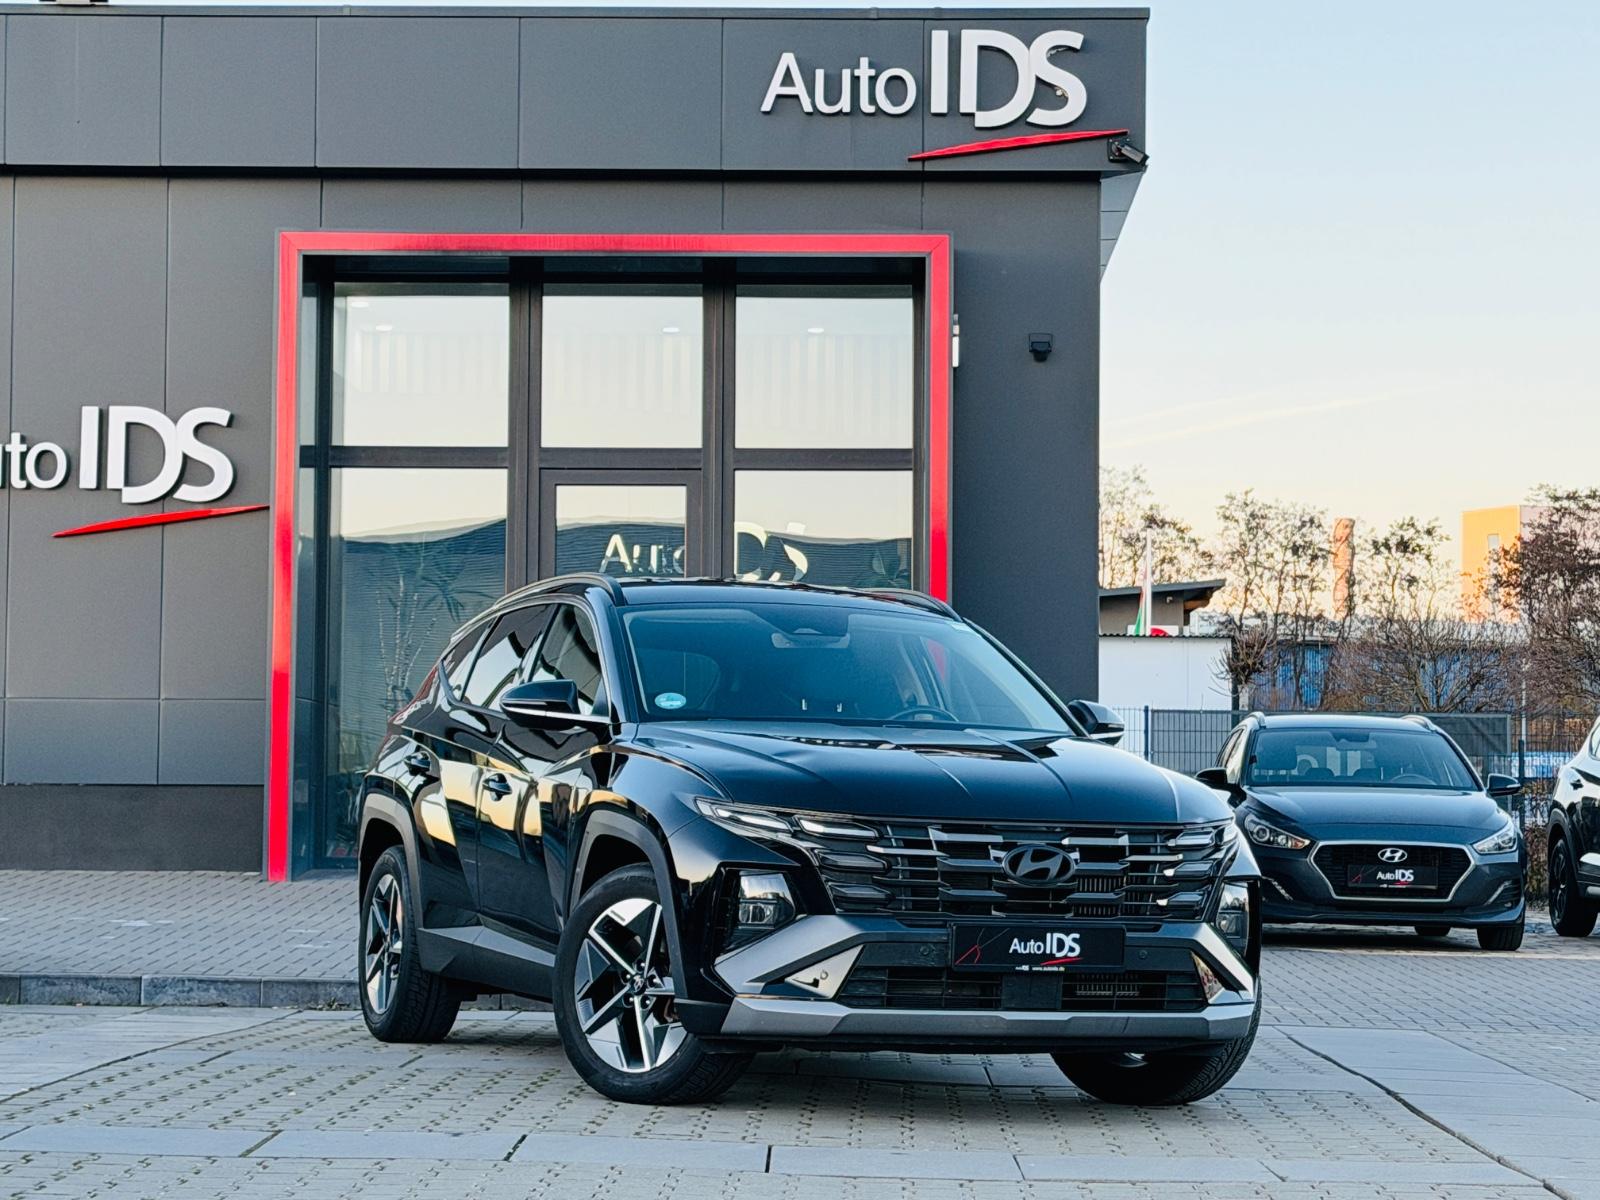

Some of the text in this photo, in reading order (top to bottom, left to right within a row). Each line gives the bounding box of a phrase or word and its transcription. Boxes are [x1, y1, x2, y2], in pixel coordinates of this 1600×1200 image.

[760, 29, 1087, 128] Auto IDS
[0, 405, 234, 503] to IDS
[1009, 932, 1081, 958] Auto IDS
